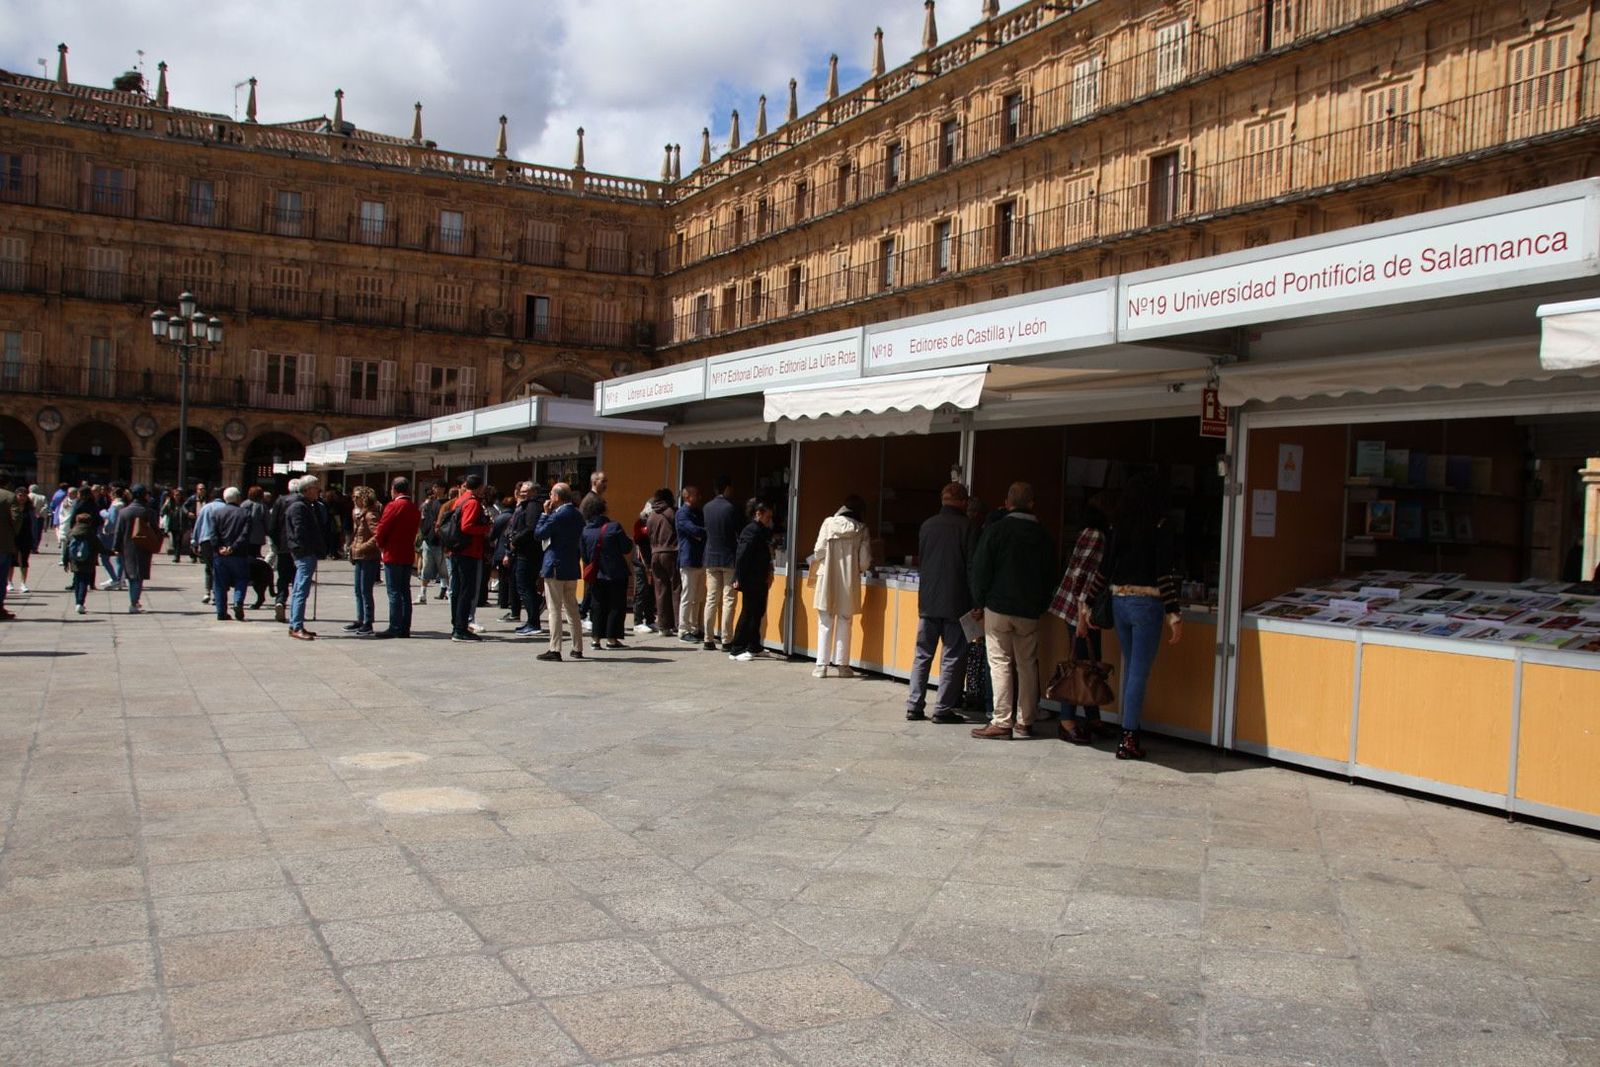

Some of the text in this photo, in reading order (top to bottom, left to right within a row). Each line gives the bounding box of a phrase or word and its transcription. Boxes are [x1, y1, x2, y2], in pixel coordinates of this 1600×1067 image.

[1128, 231, 1568, 317] Nº19 Universidad Pontificia de Salamanca
[871, 317, 1047, 359] Nº18 Editores de Castilla y León
[727, 366, 752, 383] Editorial
[753, 363, 774, 379] Delirio
[779, 356, 807, 375] Editorial
[808, 355, 818, 370] La
[820, 350, 836, 368] Uña
[837, 350, 857, 366] Rota
